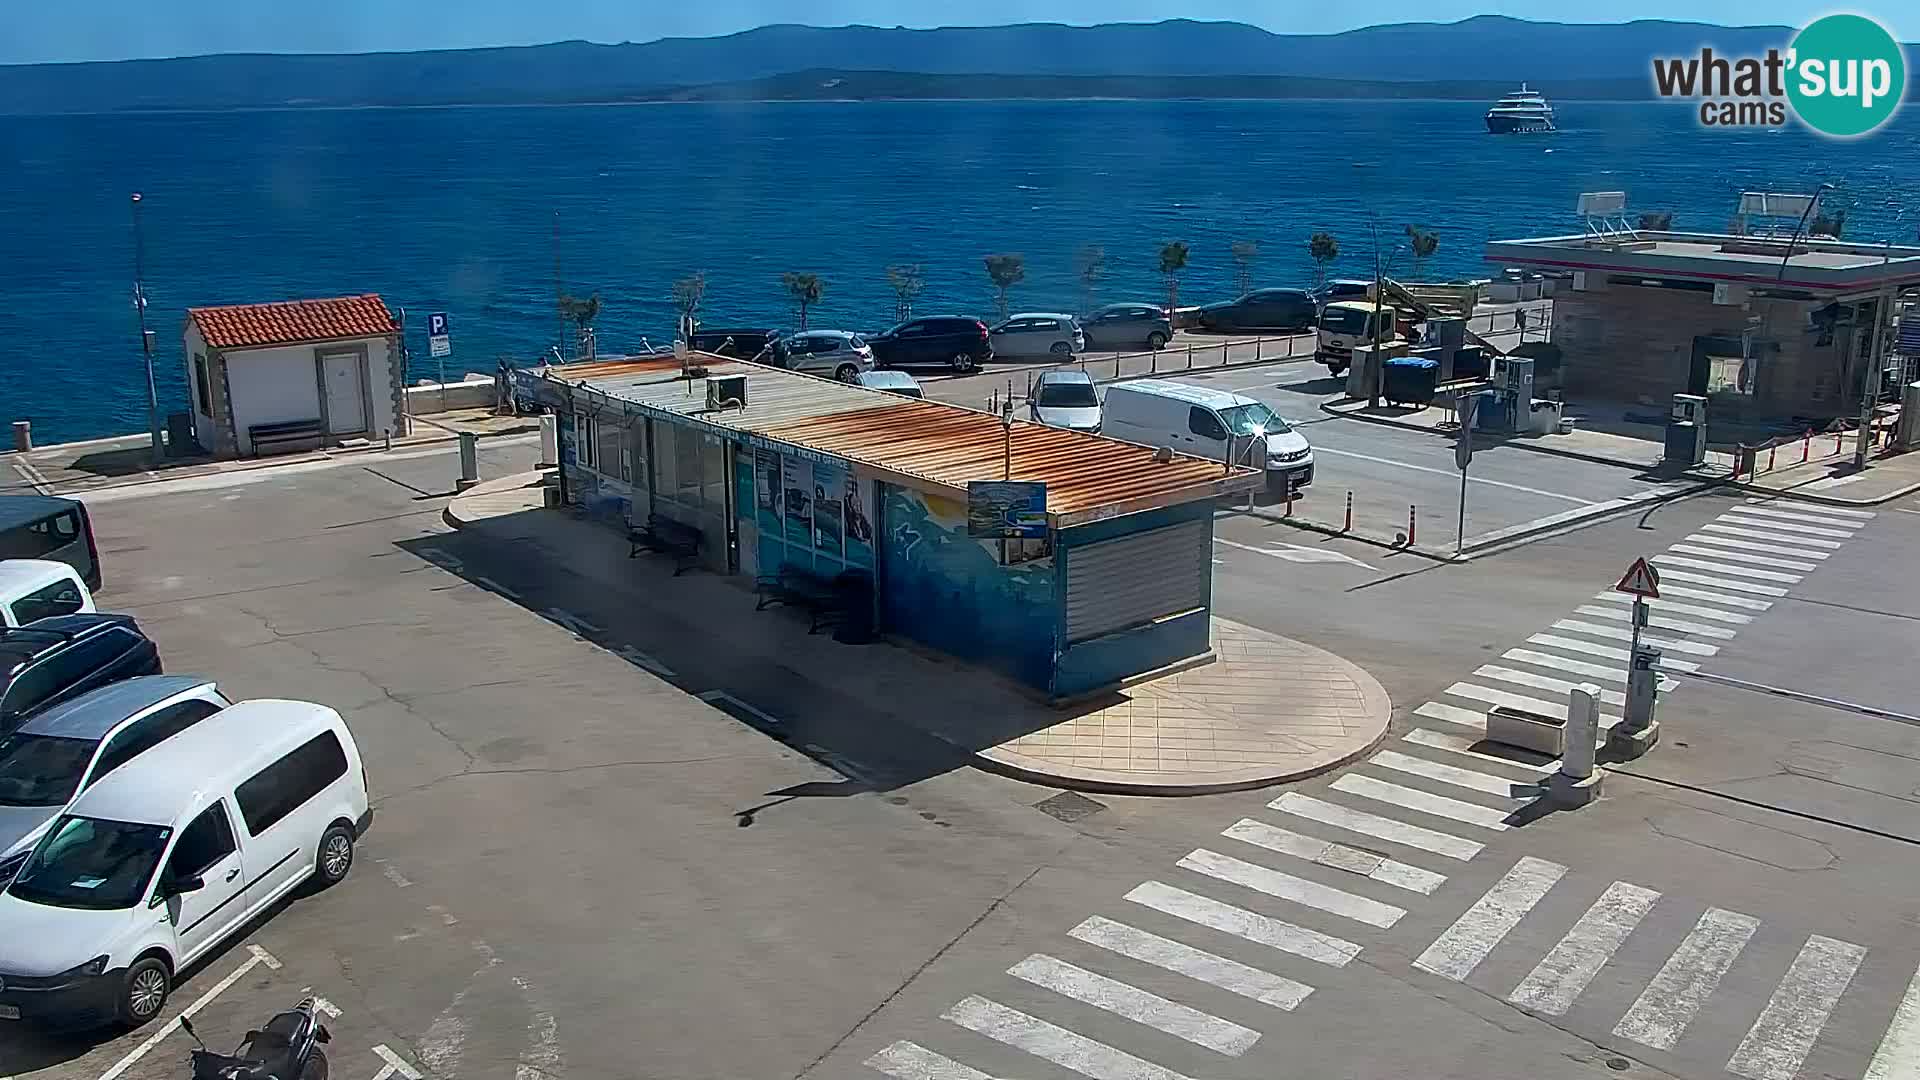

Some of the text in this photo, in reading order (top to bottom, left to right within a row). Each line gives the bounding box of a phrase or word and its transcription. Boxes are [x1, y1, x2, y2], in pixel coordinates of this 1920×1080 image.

[432, 316, 443, 333] P
[750, 436, 764, 449] BUS
[764, 440, 795, 456] STATION
[797, 448, 821, 463] TICKET
[822, 455, 849, 470] OFFICE
